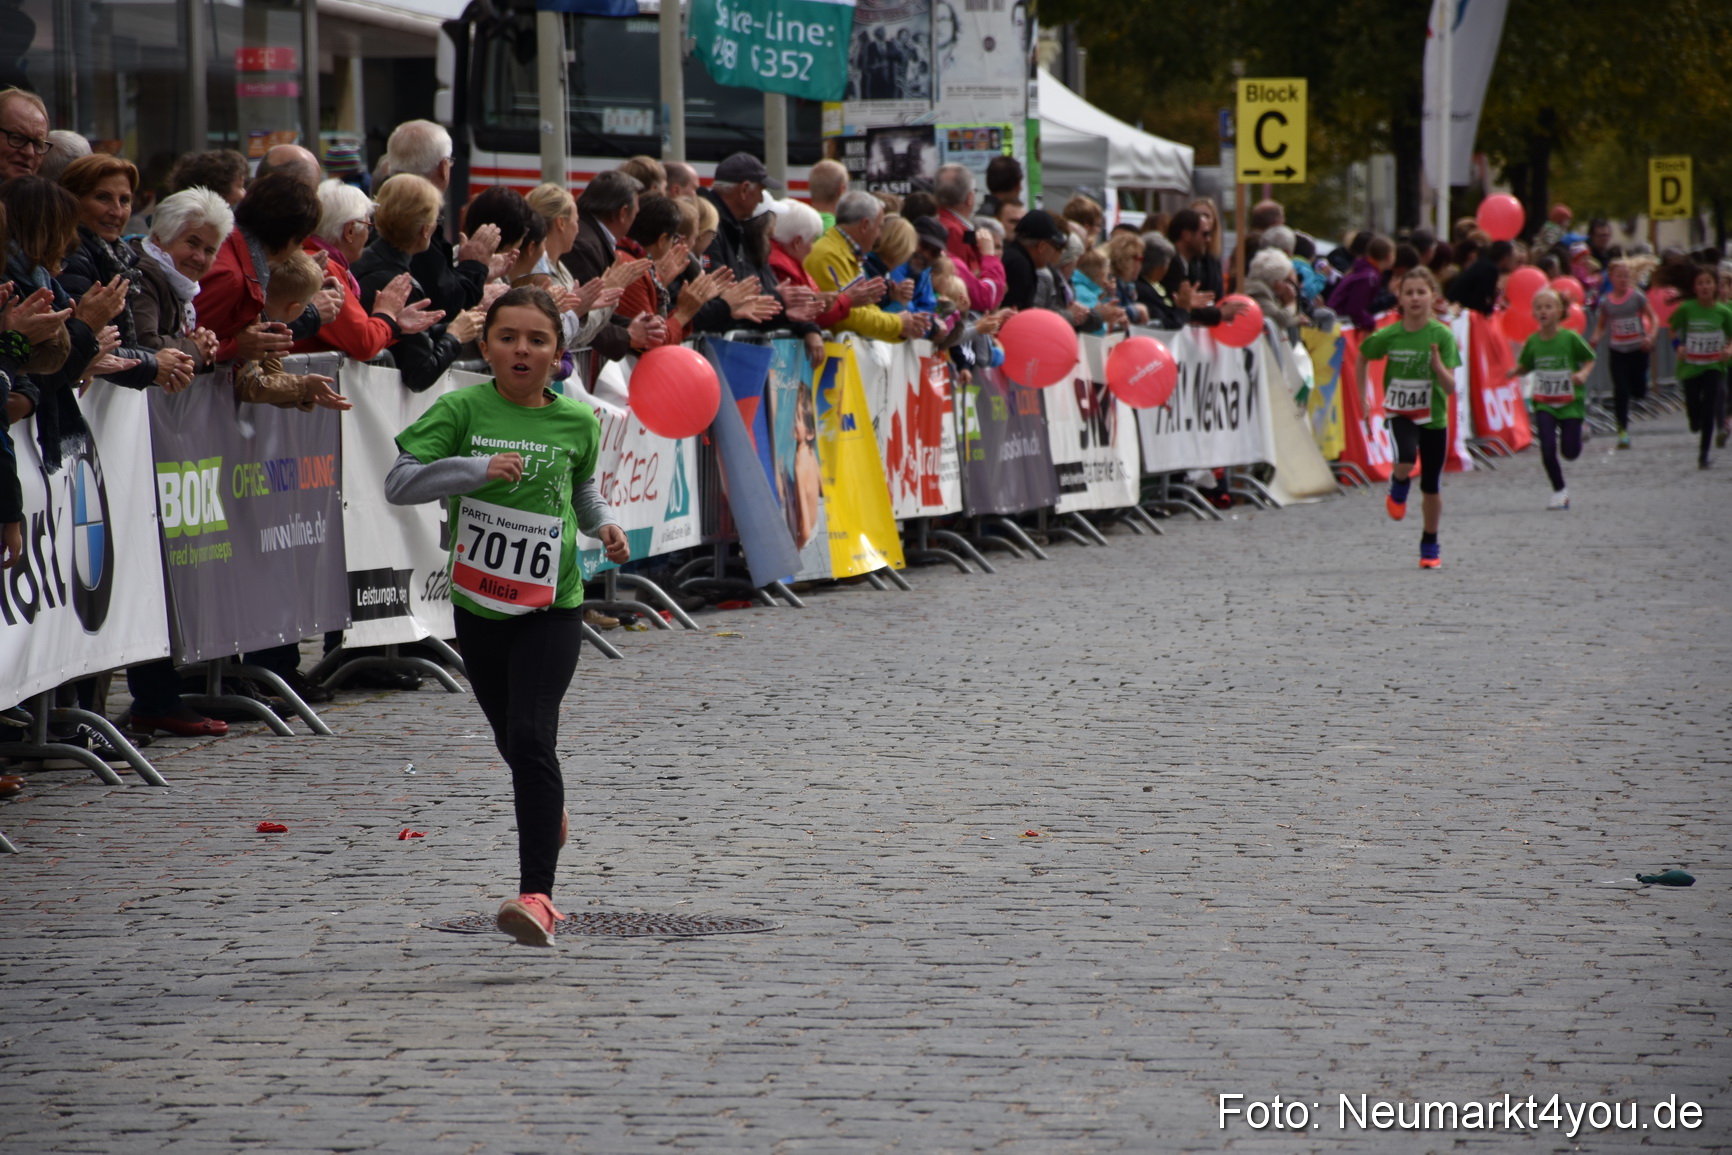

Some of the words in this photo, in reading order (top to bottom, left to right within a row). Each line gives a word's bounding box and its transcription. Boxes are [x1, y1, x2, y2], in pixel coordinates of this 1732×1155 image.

[1246, 84, 1299, 103] Block
[1255, 110, 1288, 161] C
[869, 182, 912, 194] CASH
[1661, 176, 1682, 206] D
[1538, 379, 1571, 395] 7074
[1390, 390, 1427, 409] 7044
[471, 435, 548, 453] Neumarkter
[157, 467, 227, 528] BOCK
[462, 506, 494, 525] PARTL
[496, 517, 547, 536] Neumarkt
[467, 523, 552, 579] 7016
[479, 577, 519, 601] Alicia
